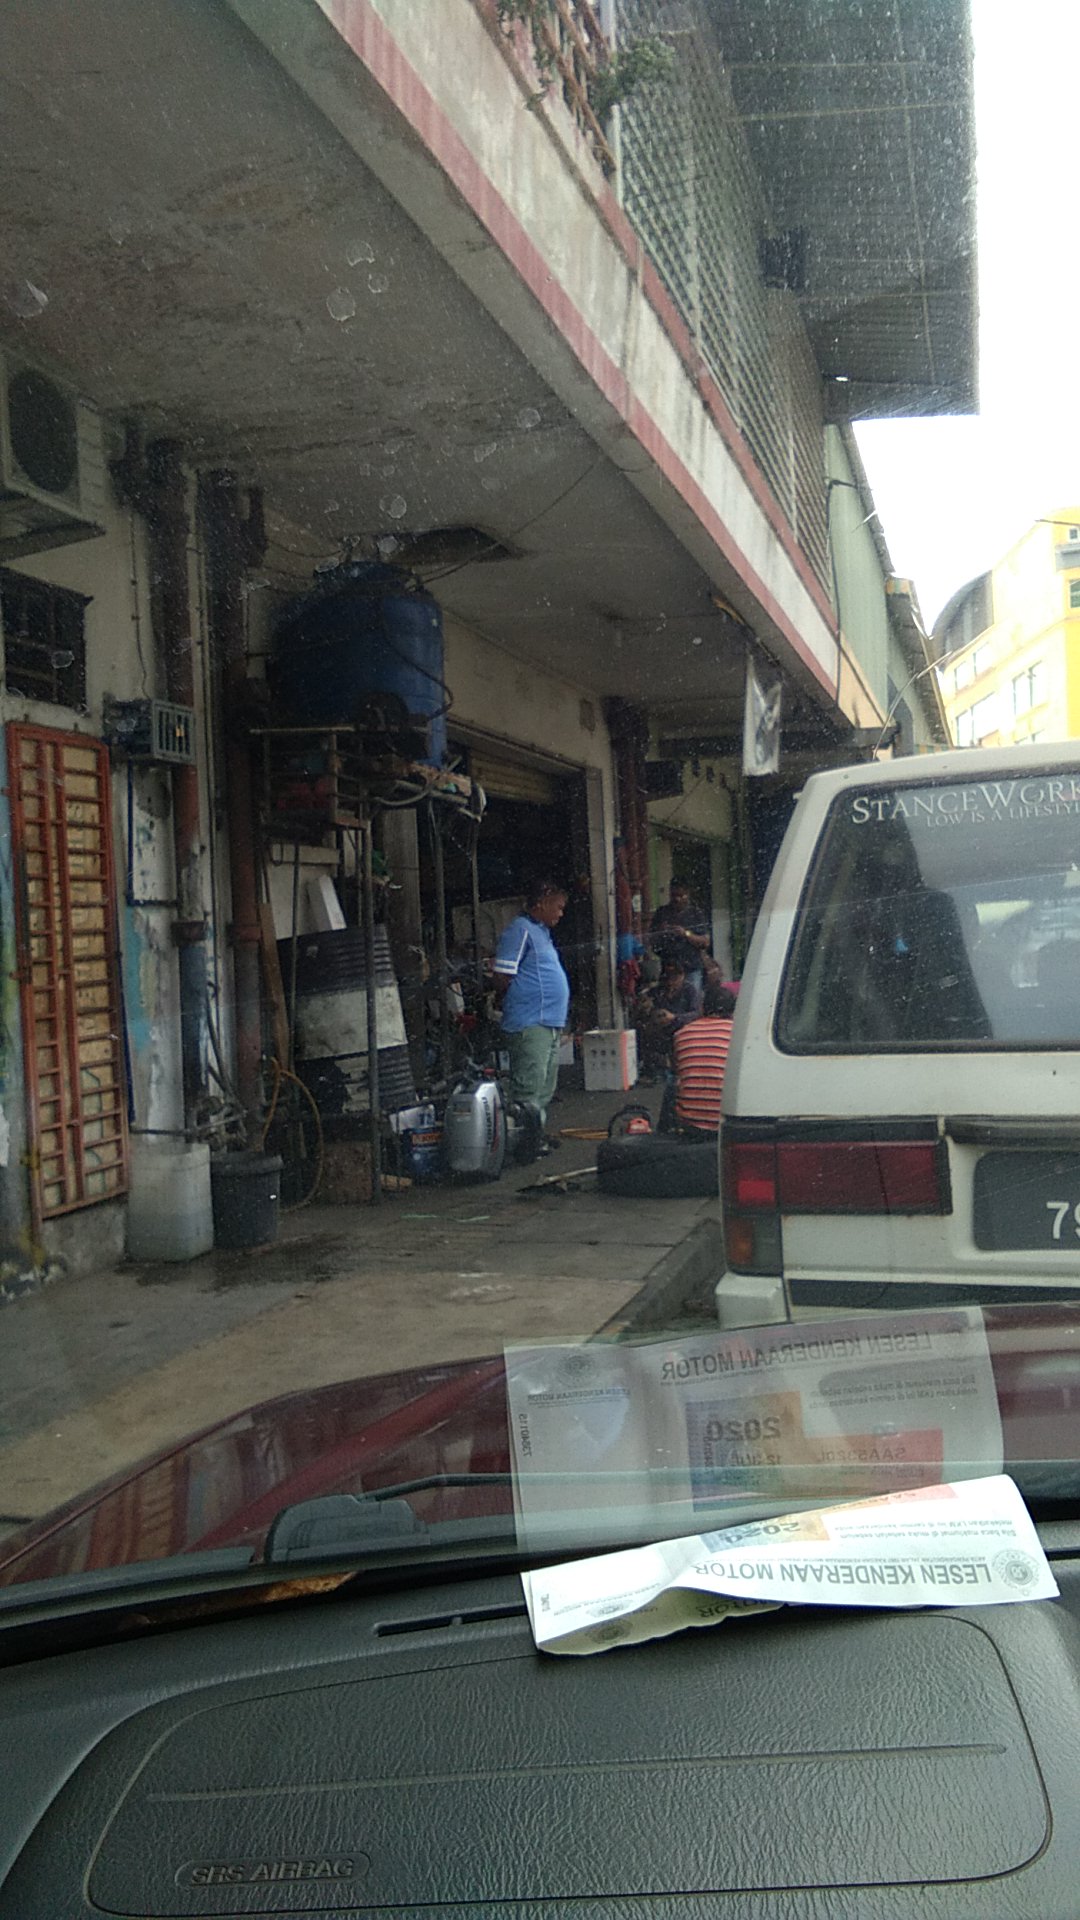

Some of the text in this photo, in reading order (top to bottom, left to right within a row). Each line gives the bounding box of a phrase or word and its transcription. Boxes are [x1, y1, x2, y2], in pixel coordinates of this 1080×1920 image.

[927, 813, 963, 827] LOW
[971, 811, 985, 823] IS
[992, 809, 1002, 822] A
[725, 1523, 801, 1543] 2020
[690, 1562, 992, 1585] LESEN KENDERAAN MOTOR
[191, 1858, 355, 1883] SRS AIRBAG
